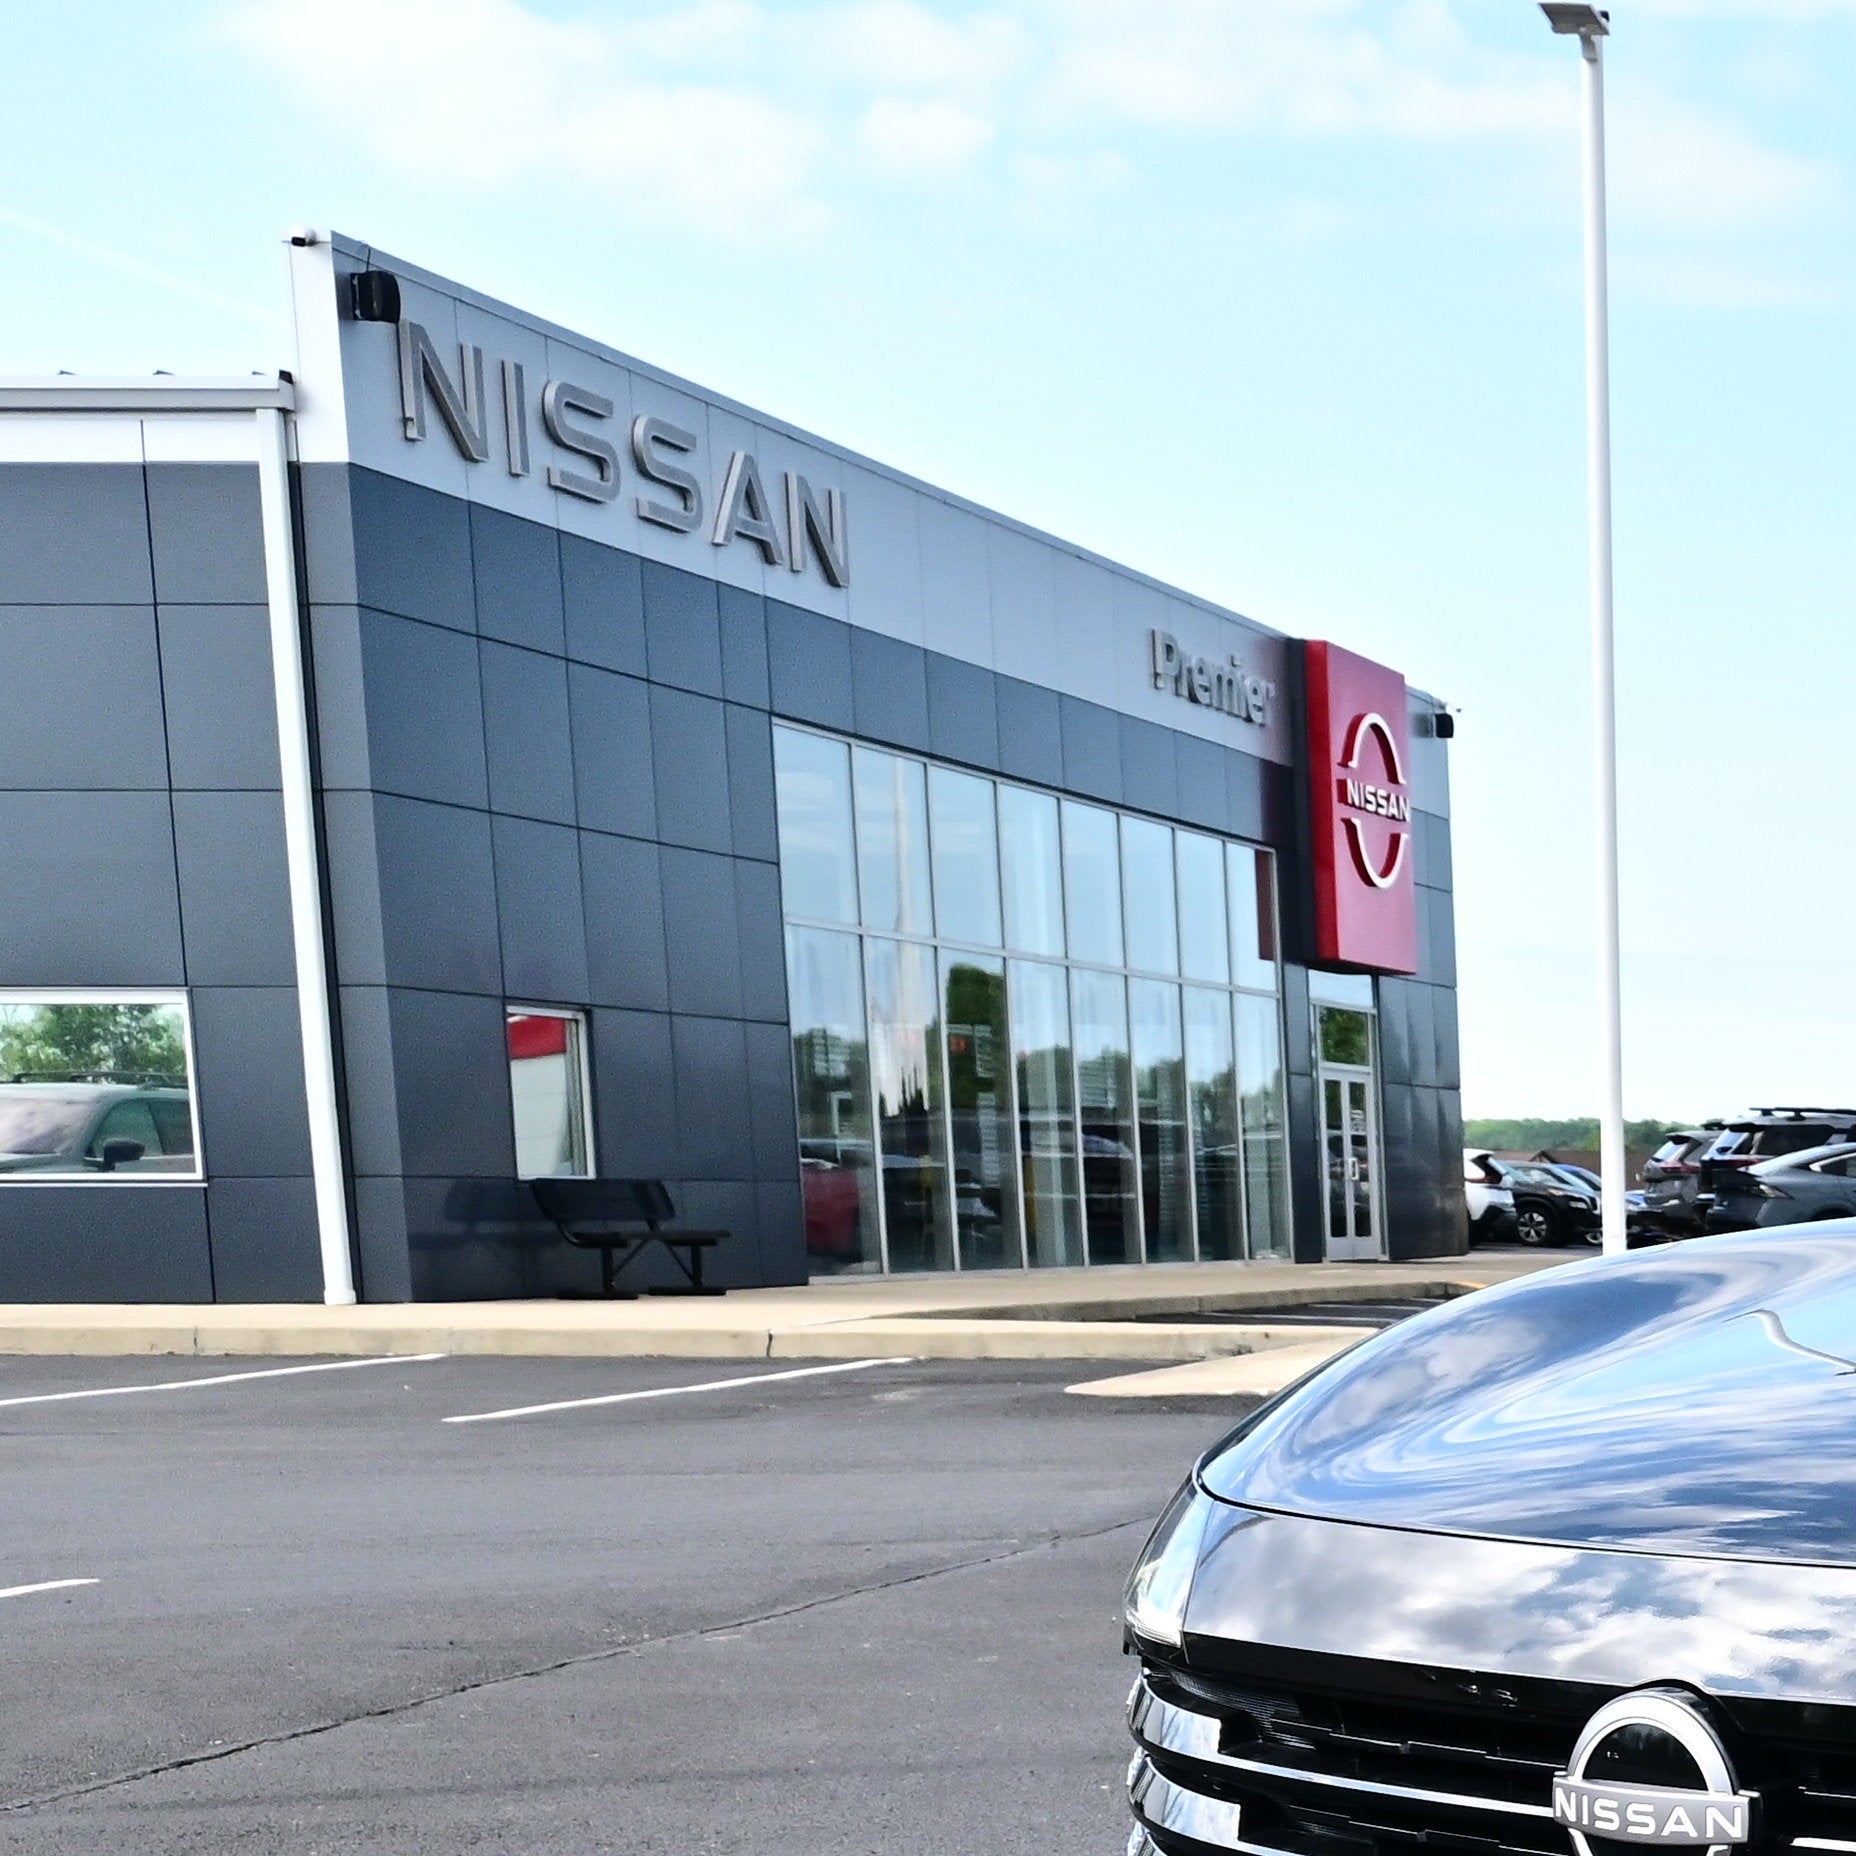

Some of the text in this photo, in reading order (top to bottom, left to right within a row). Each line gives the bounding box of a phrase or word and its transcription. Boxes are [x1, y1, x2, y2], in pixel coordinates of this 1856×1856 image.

[398, 320, 852, 589] NISSAN
[1150, 628, 1276, 726] Premier
[1346, 777, 1410, 823] NISSAN
[1554, 1786, 1744, 1839] NISSAN
